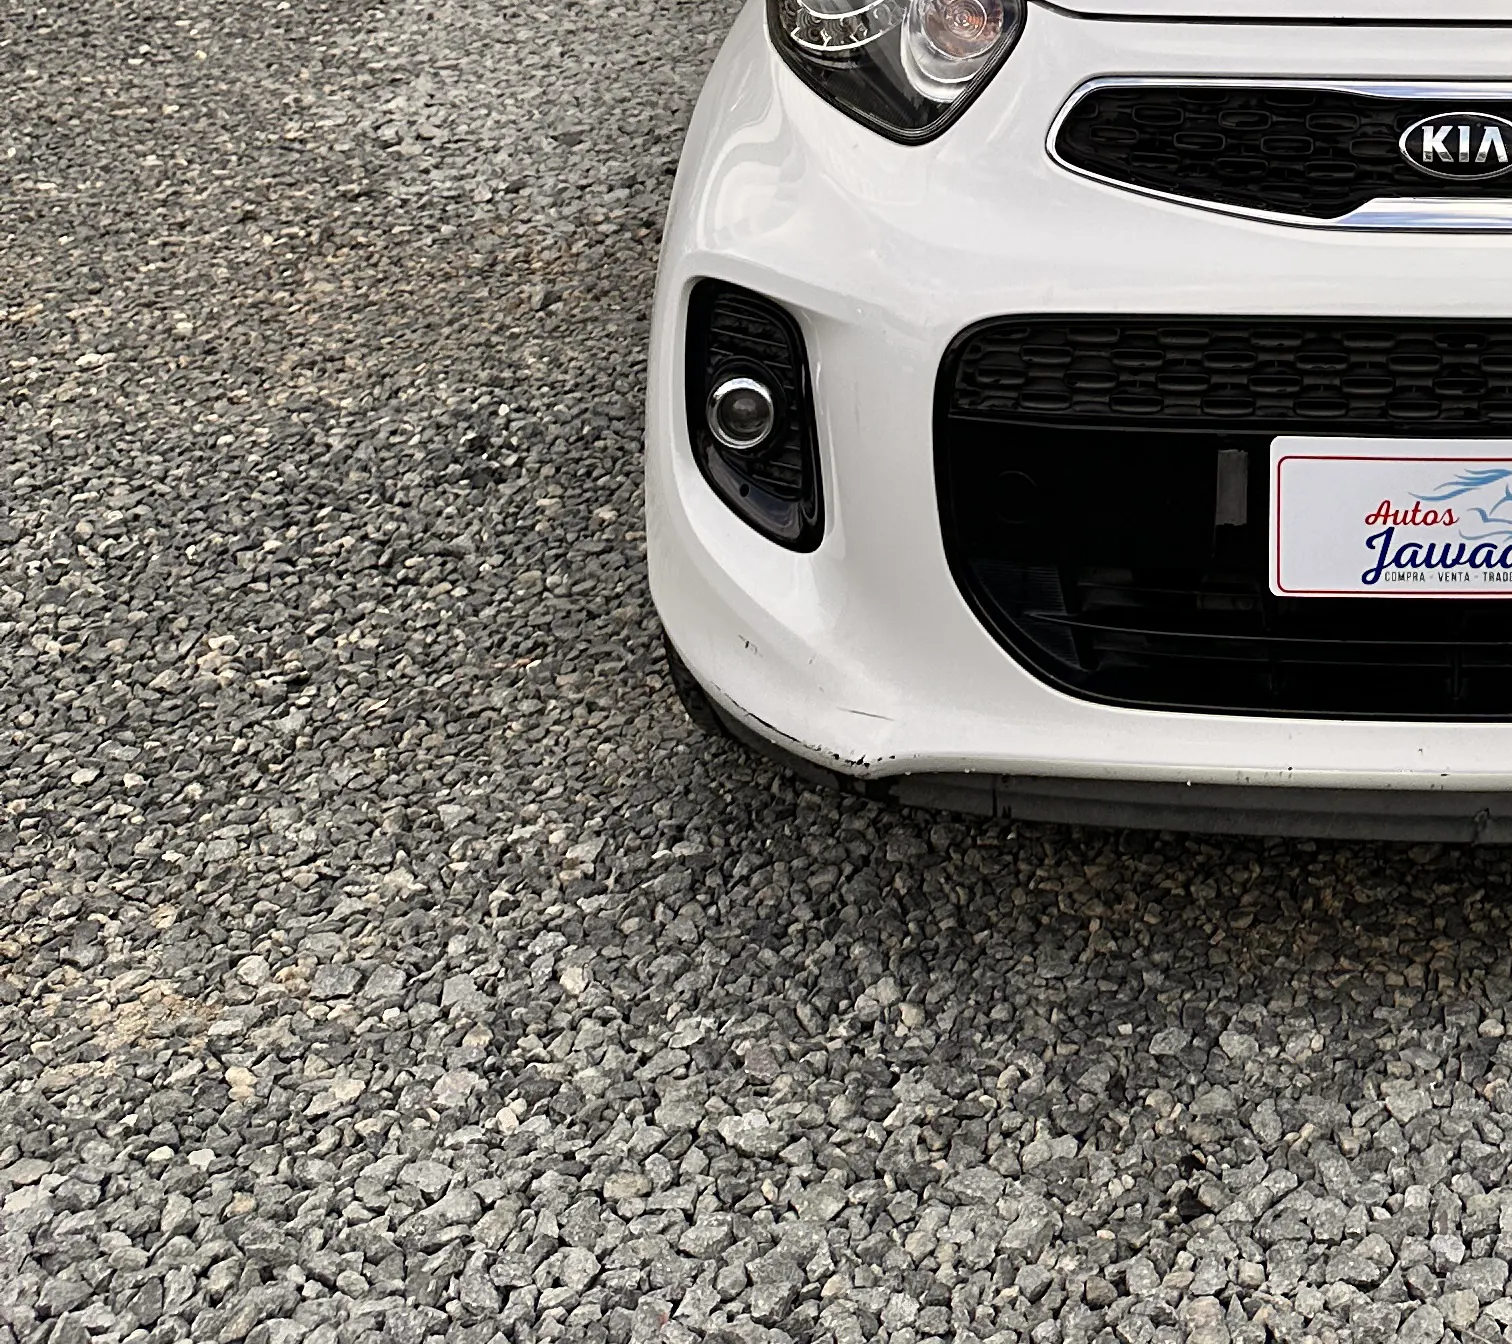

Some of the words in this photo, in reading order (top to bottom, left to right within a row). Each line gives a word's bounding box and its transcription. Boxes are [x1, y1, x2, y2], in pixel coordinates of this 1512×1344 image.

[1421, 125, 1509, 163] KIA
[1364, 499, 1461, 526] Autos
[1384, 571, 1426, 582] COMPRA
[1437, 571, 1471, 582] VENTA
